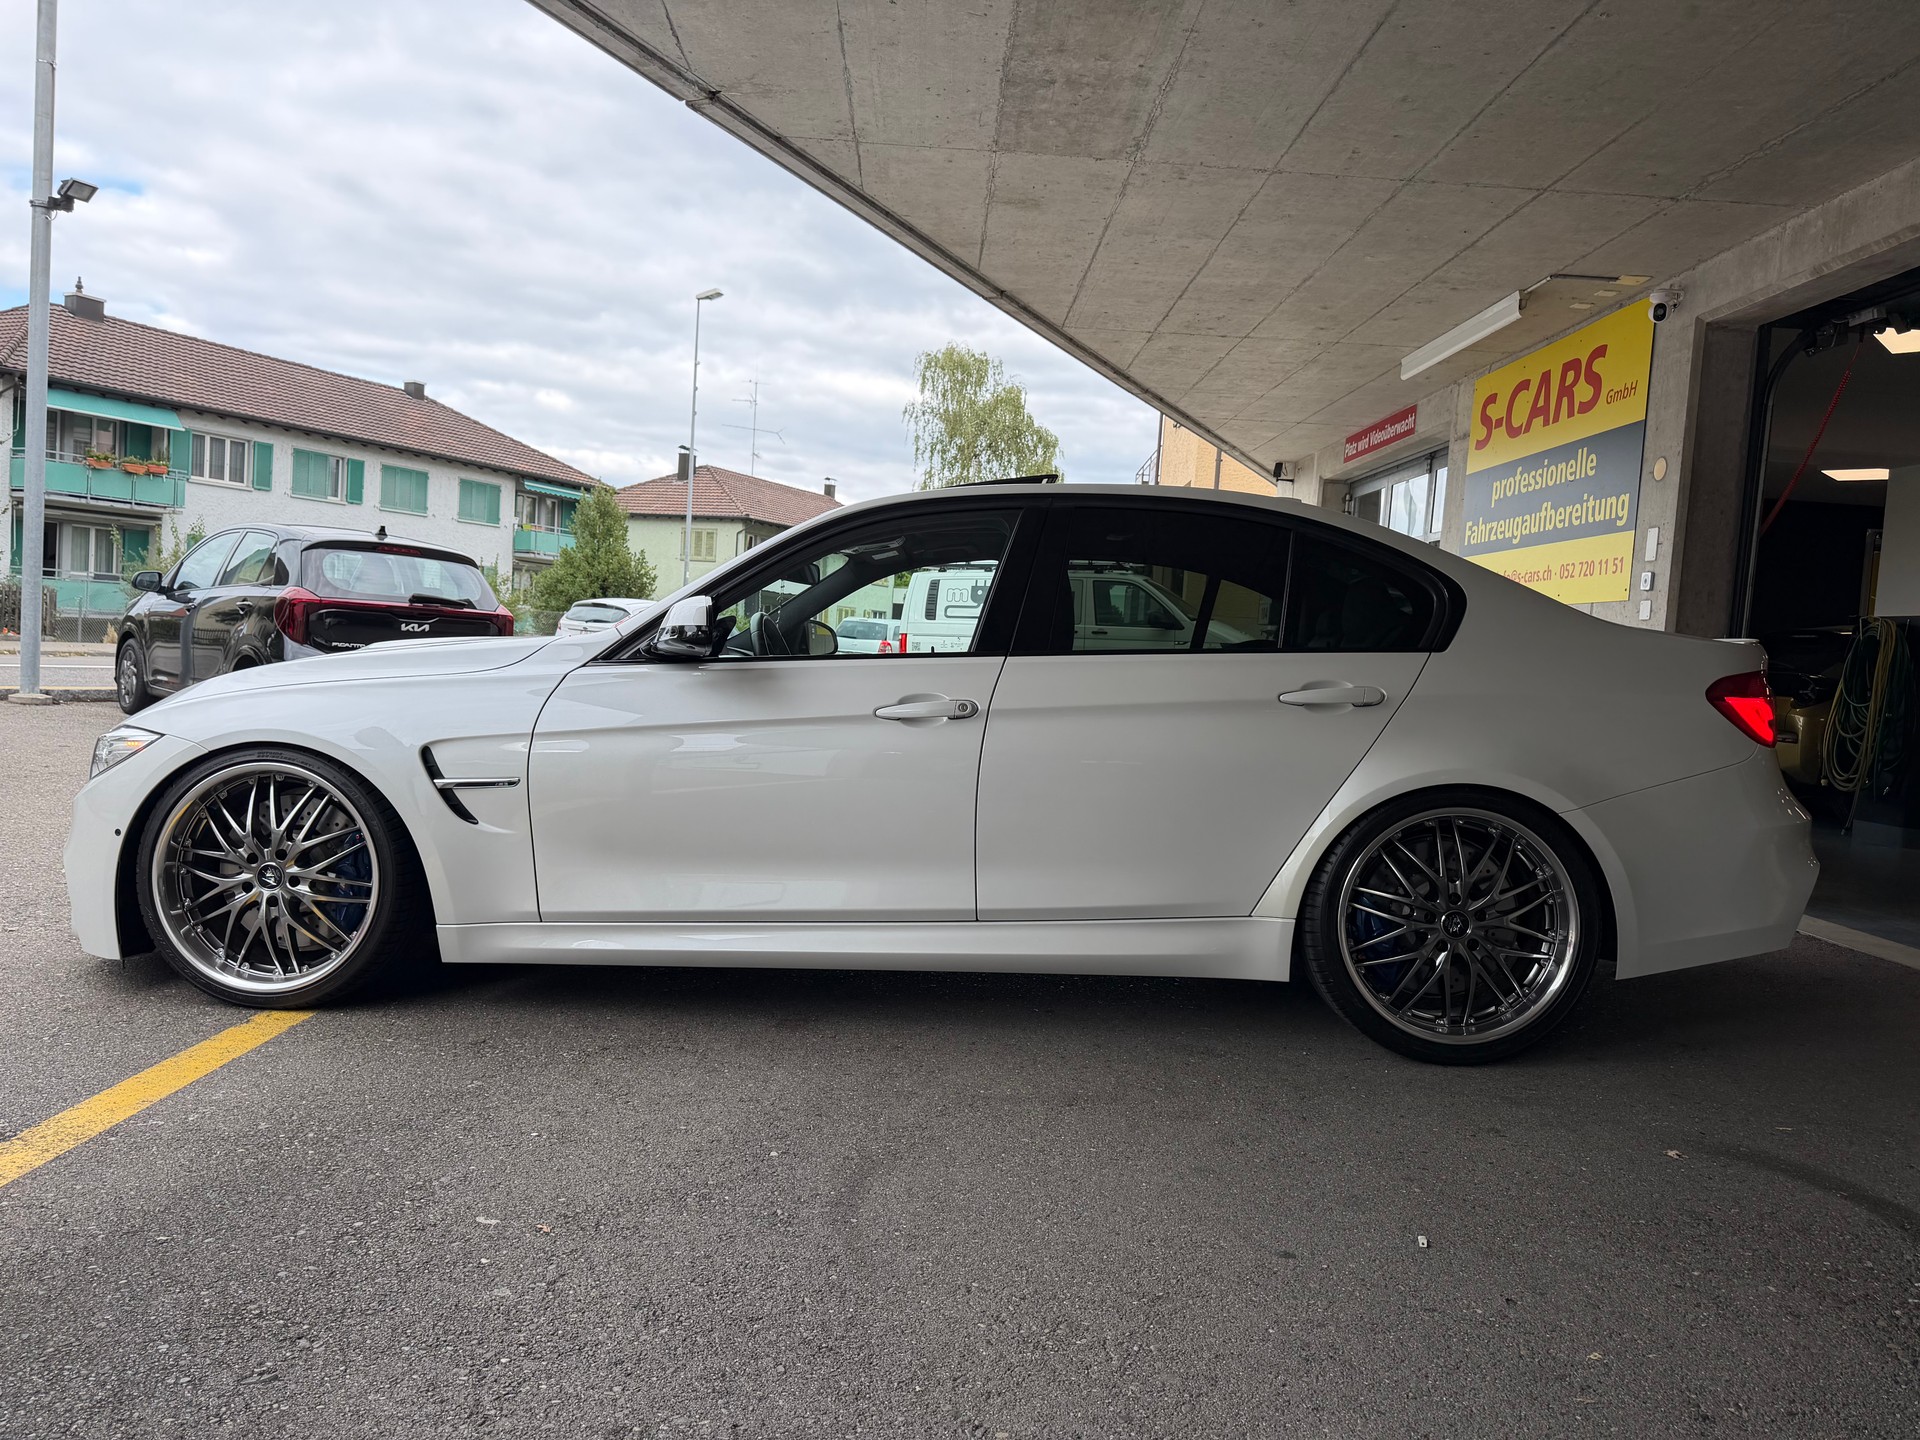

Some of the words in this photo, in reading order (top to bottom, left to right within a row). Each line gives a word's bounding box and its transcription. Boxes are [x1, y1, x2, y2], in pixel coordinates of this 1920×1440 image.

[1474, 344, 1608, 451] S-CARS
[1606, 379, 1639, 405] GmbH
[1344, 441, 1358, 458] Platz
[1358, 434, 1370, 452] wird
[1491, 447, 1597, 508] professionelle
[1464, 493, 1630, 546] Fahrzeugaufbereitung
[1559, 562, 1576, 580] 052
[1578, 560, 1595, 578] 720
[1598, 558, 1609, 576] 11
[1612, 556, 1625, 574] 51
[401, 623, 430, 632] KIA
